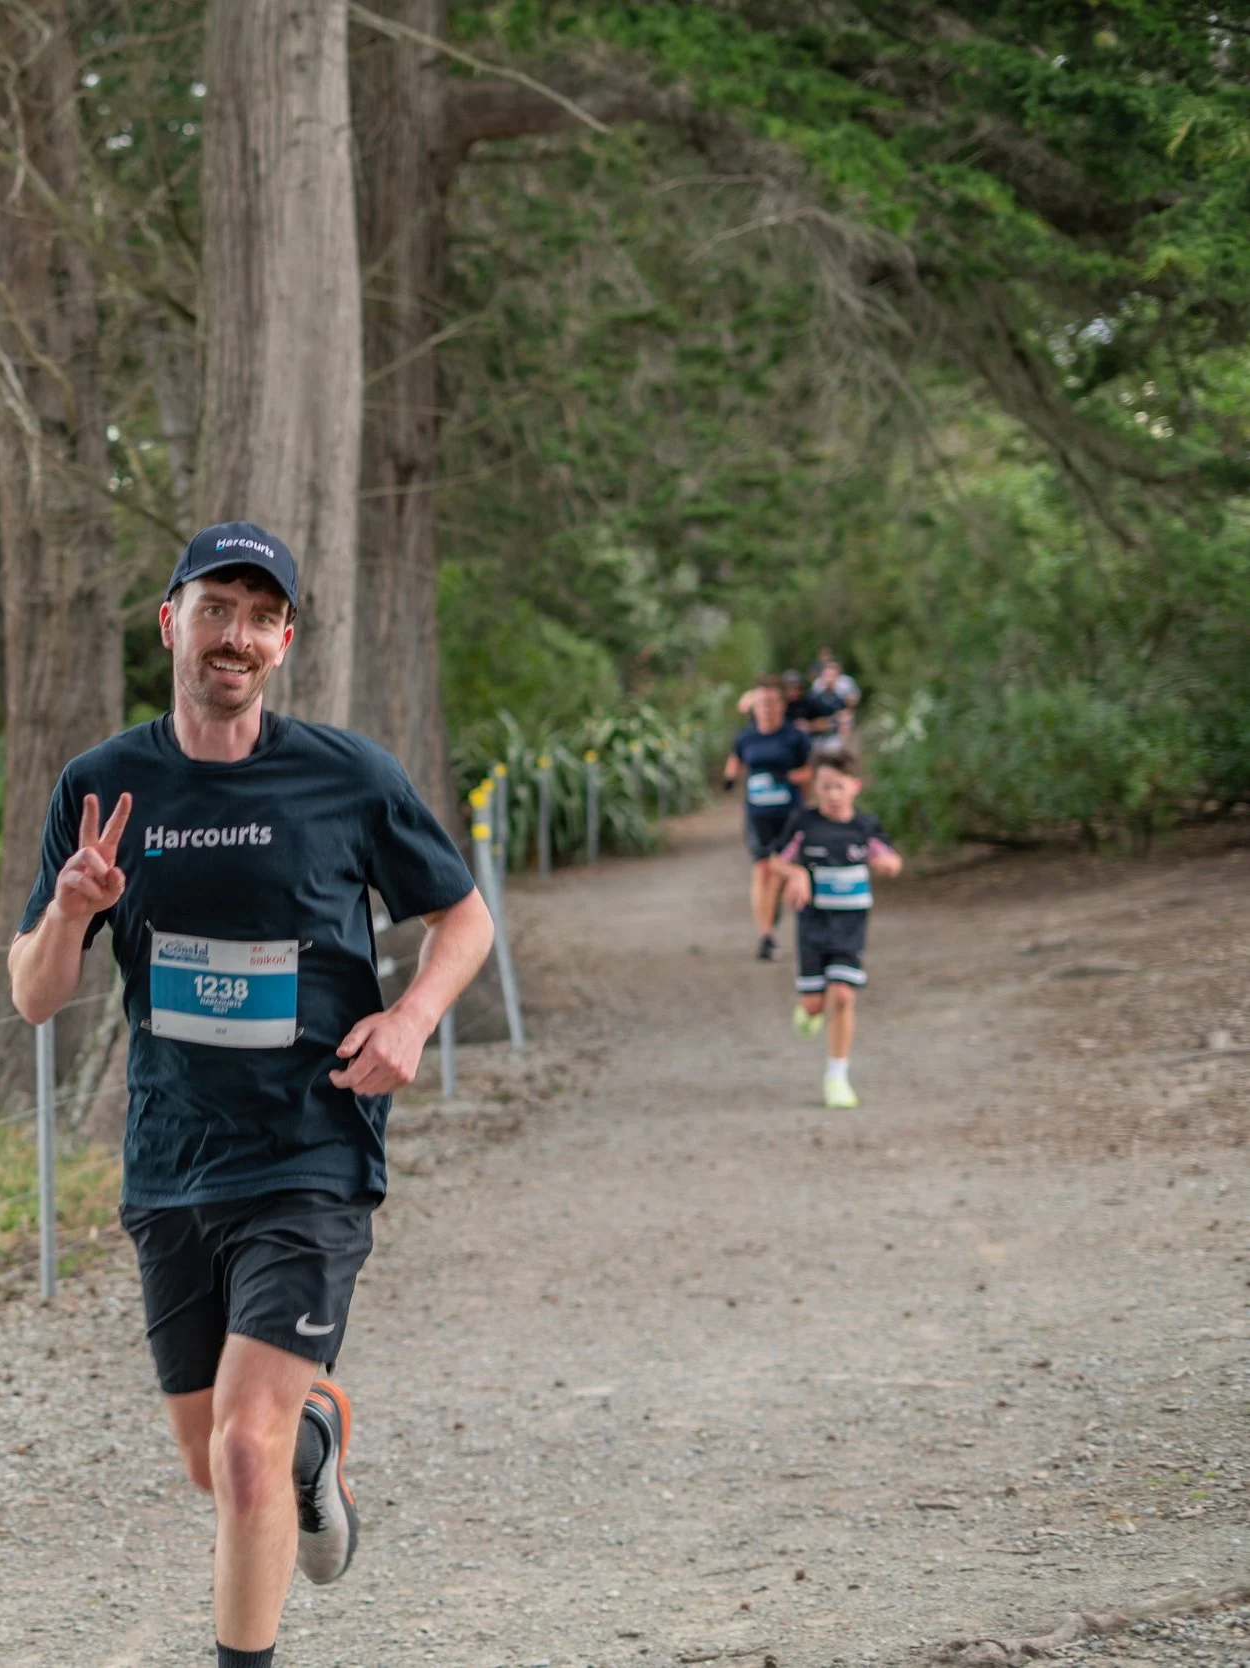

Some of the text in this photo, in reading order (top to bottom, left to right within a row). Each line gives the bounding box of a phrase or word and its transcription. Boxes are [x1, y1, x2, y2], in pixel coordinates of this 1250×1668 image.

[216, 538, 275, 559] Harcourts
[144, 822, 272, 850] Harcourts
[193, 974, 249, 1001] 1238
